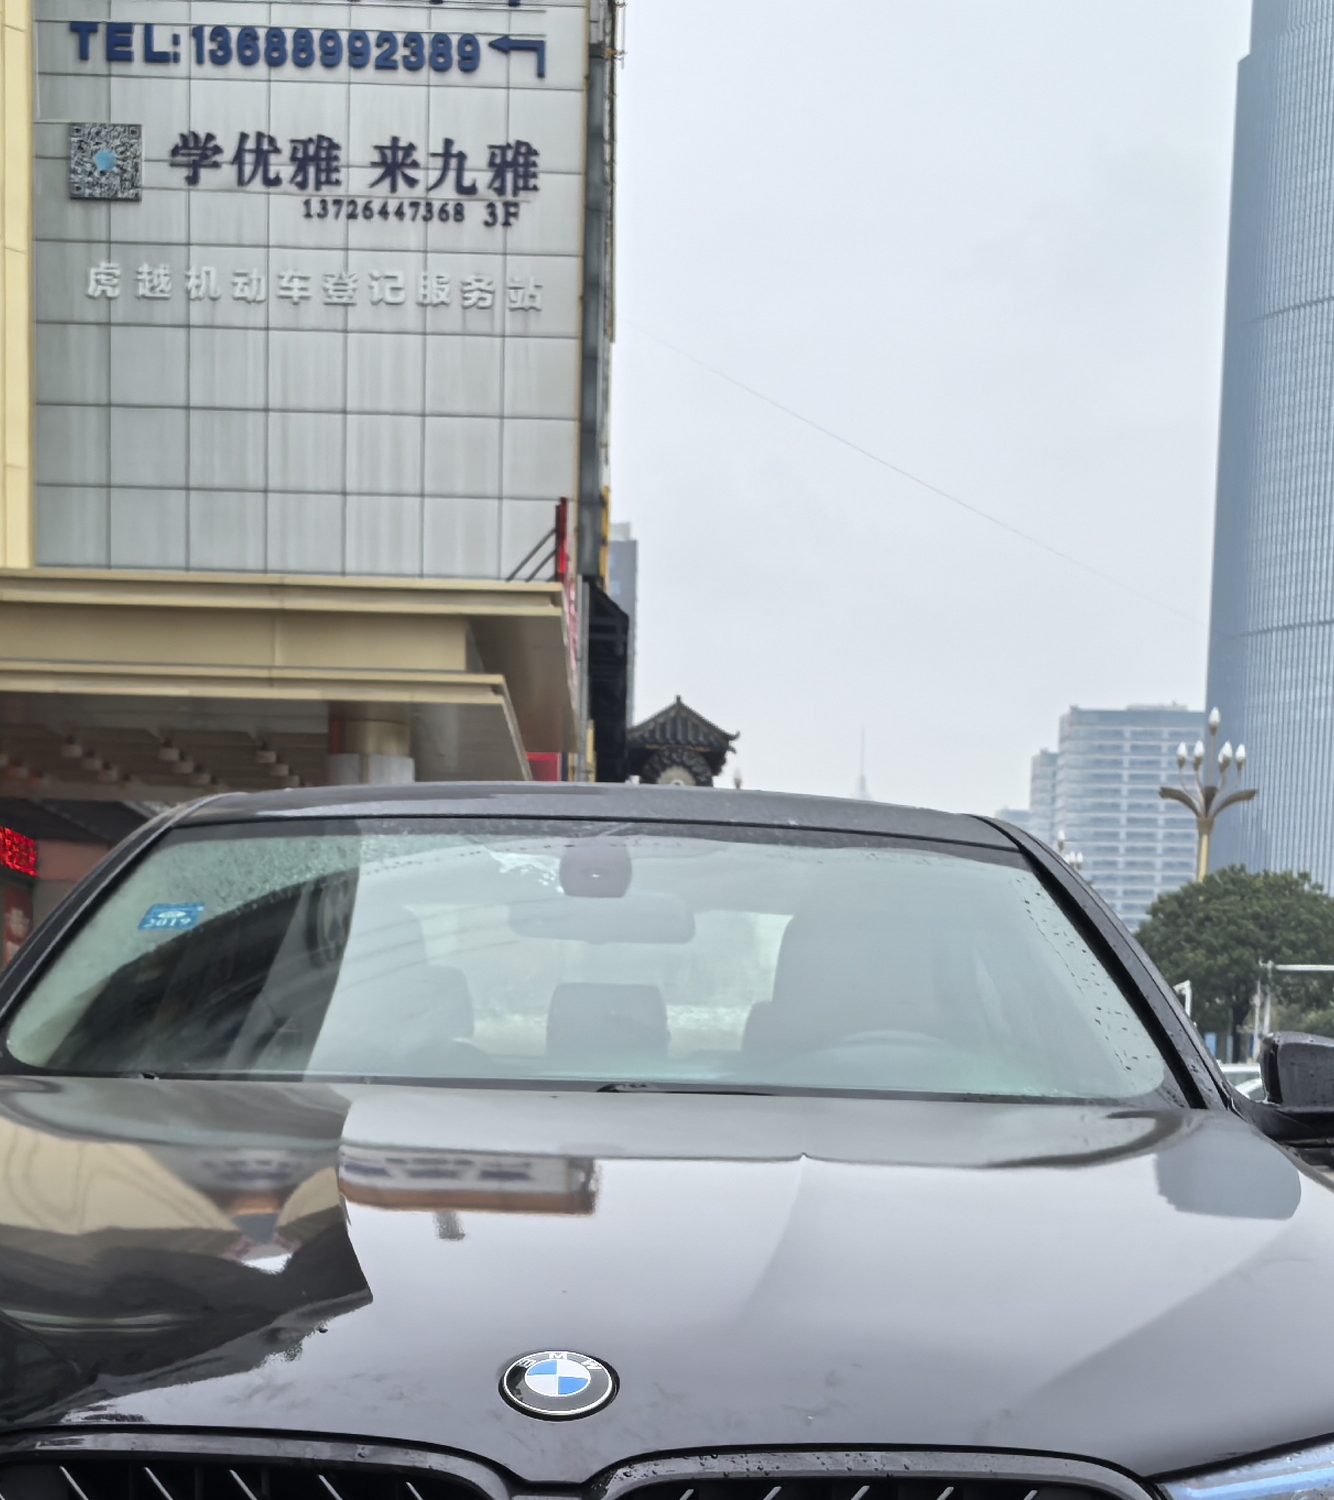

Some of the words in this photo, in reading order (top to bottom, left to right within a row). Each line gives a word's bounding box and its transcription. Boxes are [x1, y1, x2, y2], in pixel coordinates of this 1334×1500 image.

[69, 20, 481, 73] TEL:13688992389
[170, 132, 343, 191] 学优雅
[369, 136, 541, 198] 来九雅
[303, 198, 466, 223] 13726447368
[484, 202, 520, 227] 3F
[85, 261, 544, 312] 虎越机动车登记服务站
[518, 1352, 602, 1370] BMW
